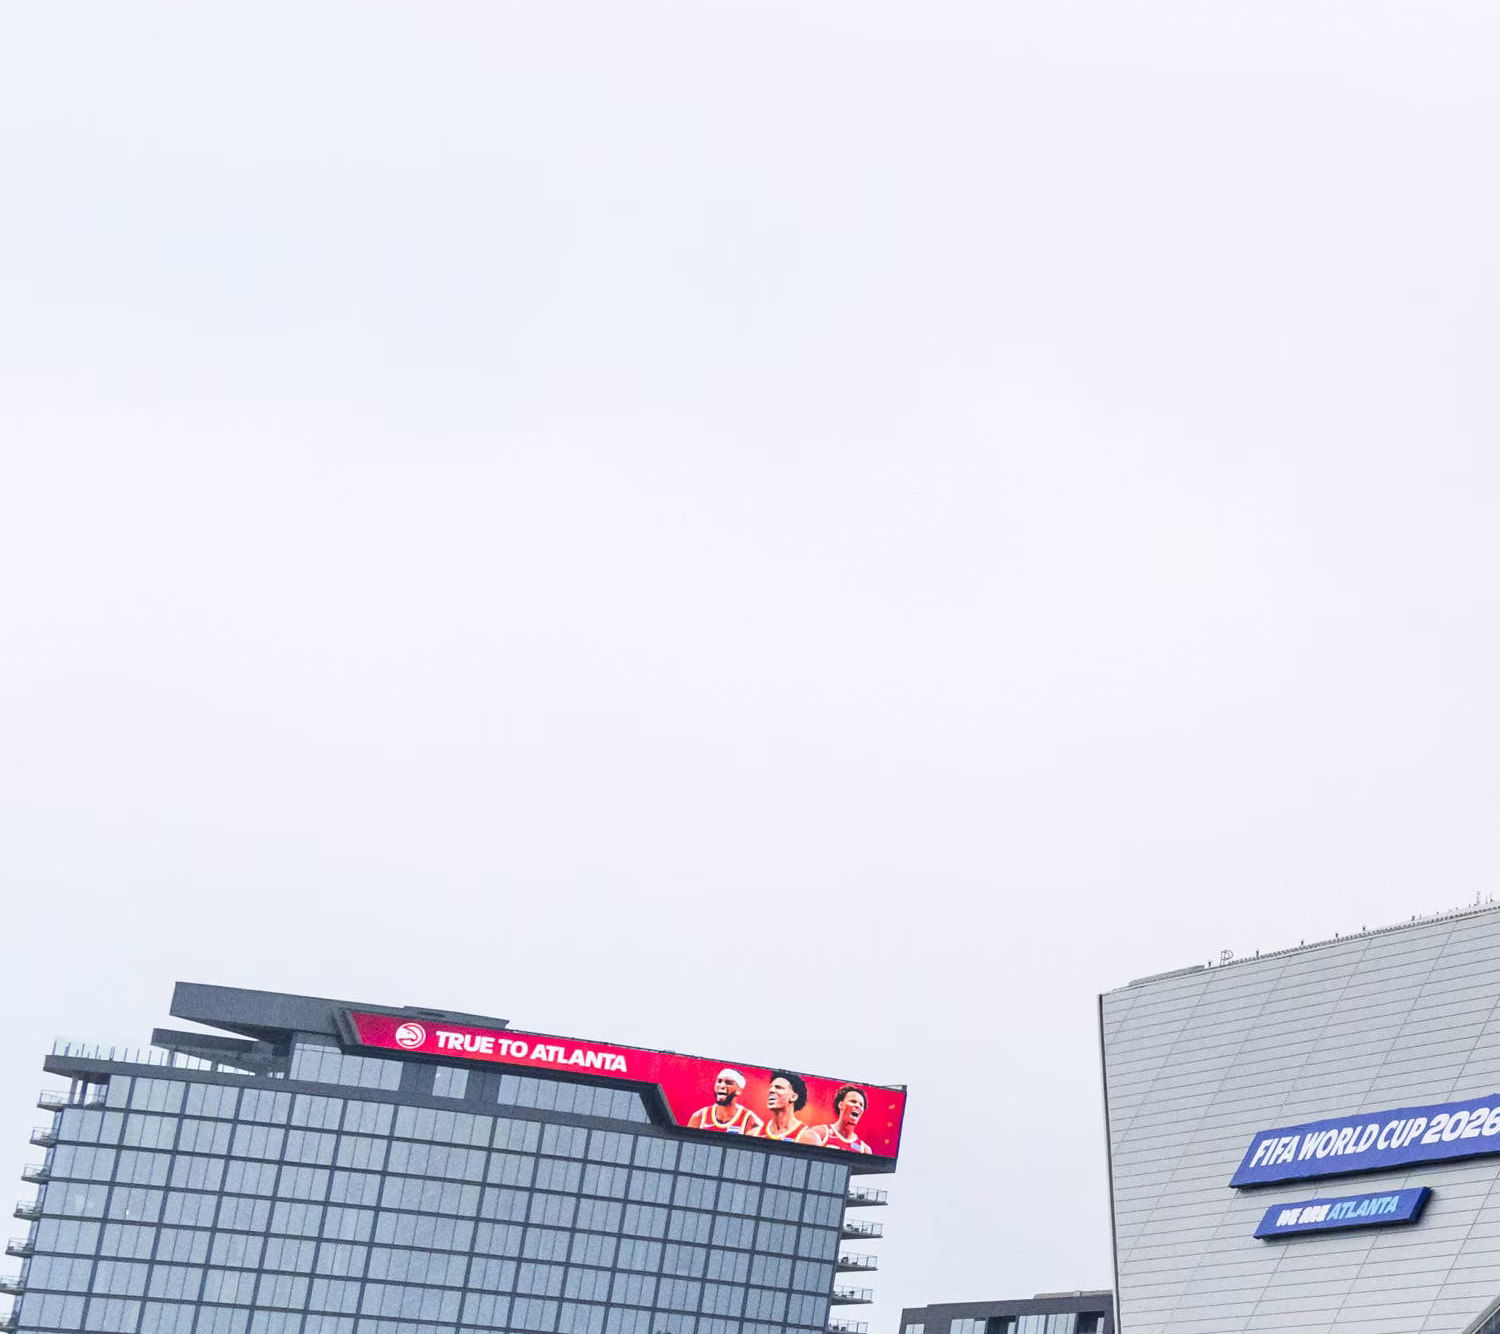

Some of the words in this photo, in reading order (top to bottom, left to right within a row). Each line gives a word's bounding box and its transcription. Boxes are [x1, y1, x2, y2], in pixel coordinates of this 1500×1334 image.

[435, 1030, 495, 1054] TRUE
[498, 1039, 528, 1058] TO
[530, 1044, 627, 1073] ATLANTA
[1250, 1135, 1300, 1168] FIFA
[1298, 1124, 1380, 1160] WORLD
[1377, 1117, 1428, 1150] CUP
[1327, 1195, 1400, 1220] ATLANTA
